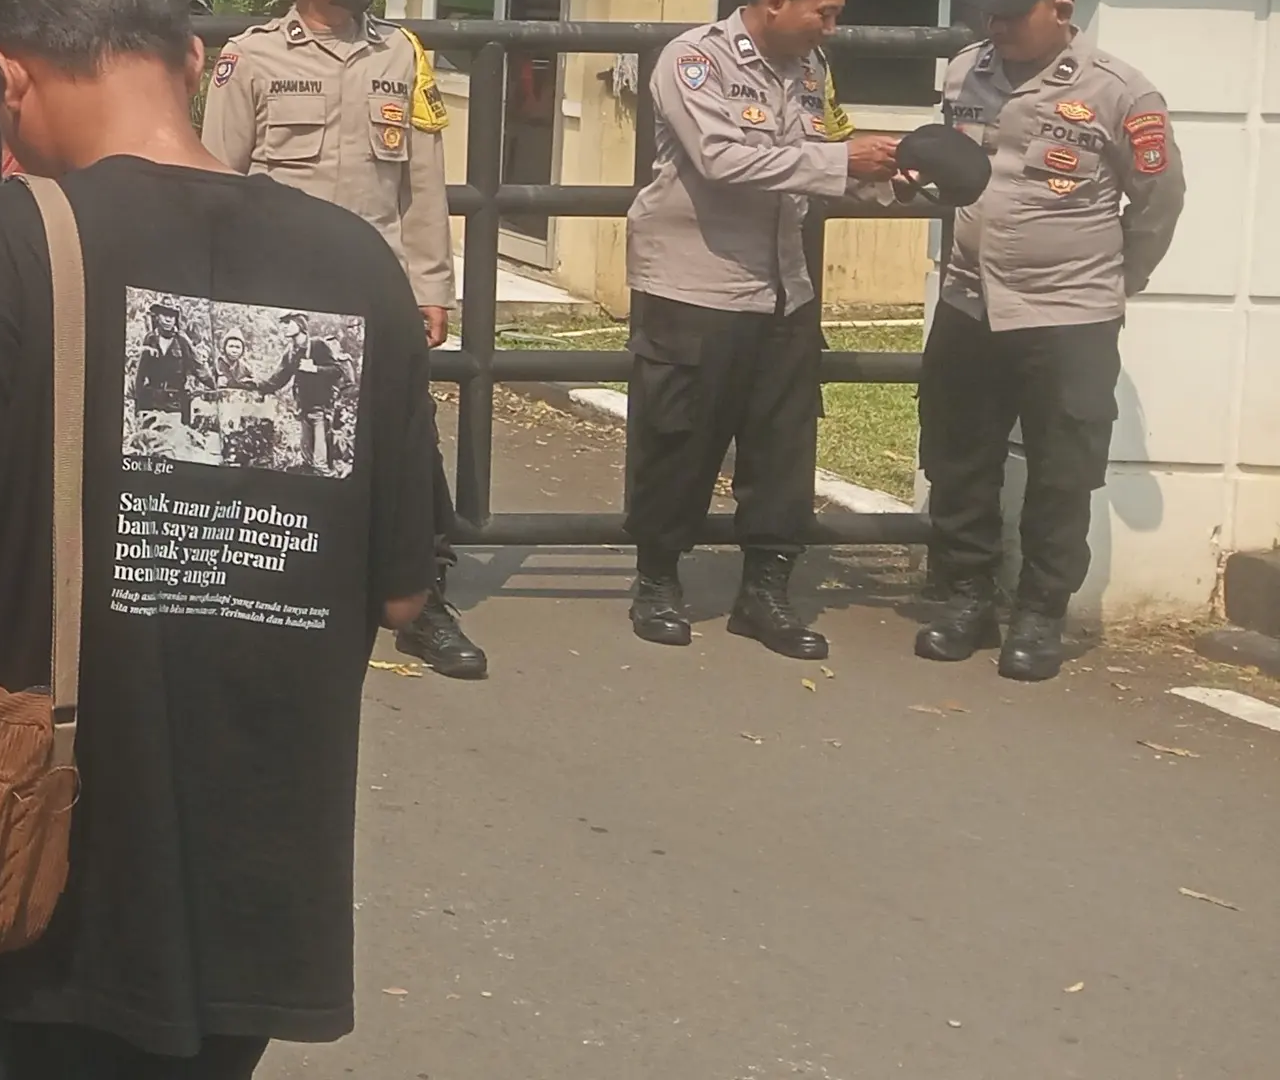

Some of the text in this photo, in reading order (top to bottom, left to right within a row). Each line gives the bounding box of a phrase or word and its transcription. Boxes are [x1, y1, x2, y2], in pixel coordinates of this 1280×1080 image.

[299, 80, 322, 93] BAYU
[371, 79, 409, 96] POLRI
[1040, 122, 1104, 150] POLRI
[172, 500, 210, 519] mau
[211, 500, 241, 522] jadi
[243, 504, 308, 530] pohon
[161, 520, 198, 542] saya
[201, 525, 235, 541] mau
[238, 527, 319, 553] menjadi
[180, 546, 219, 566] yang
[221, 544, 287, 572] berani
[182, 566, 226, 588] angin
[111, 588, 140, 603] Hidup
[110, 600, 128, 613] kita
[220, 606, 265, 623] Terimalah
[266, 614, 284, 625] dan
